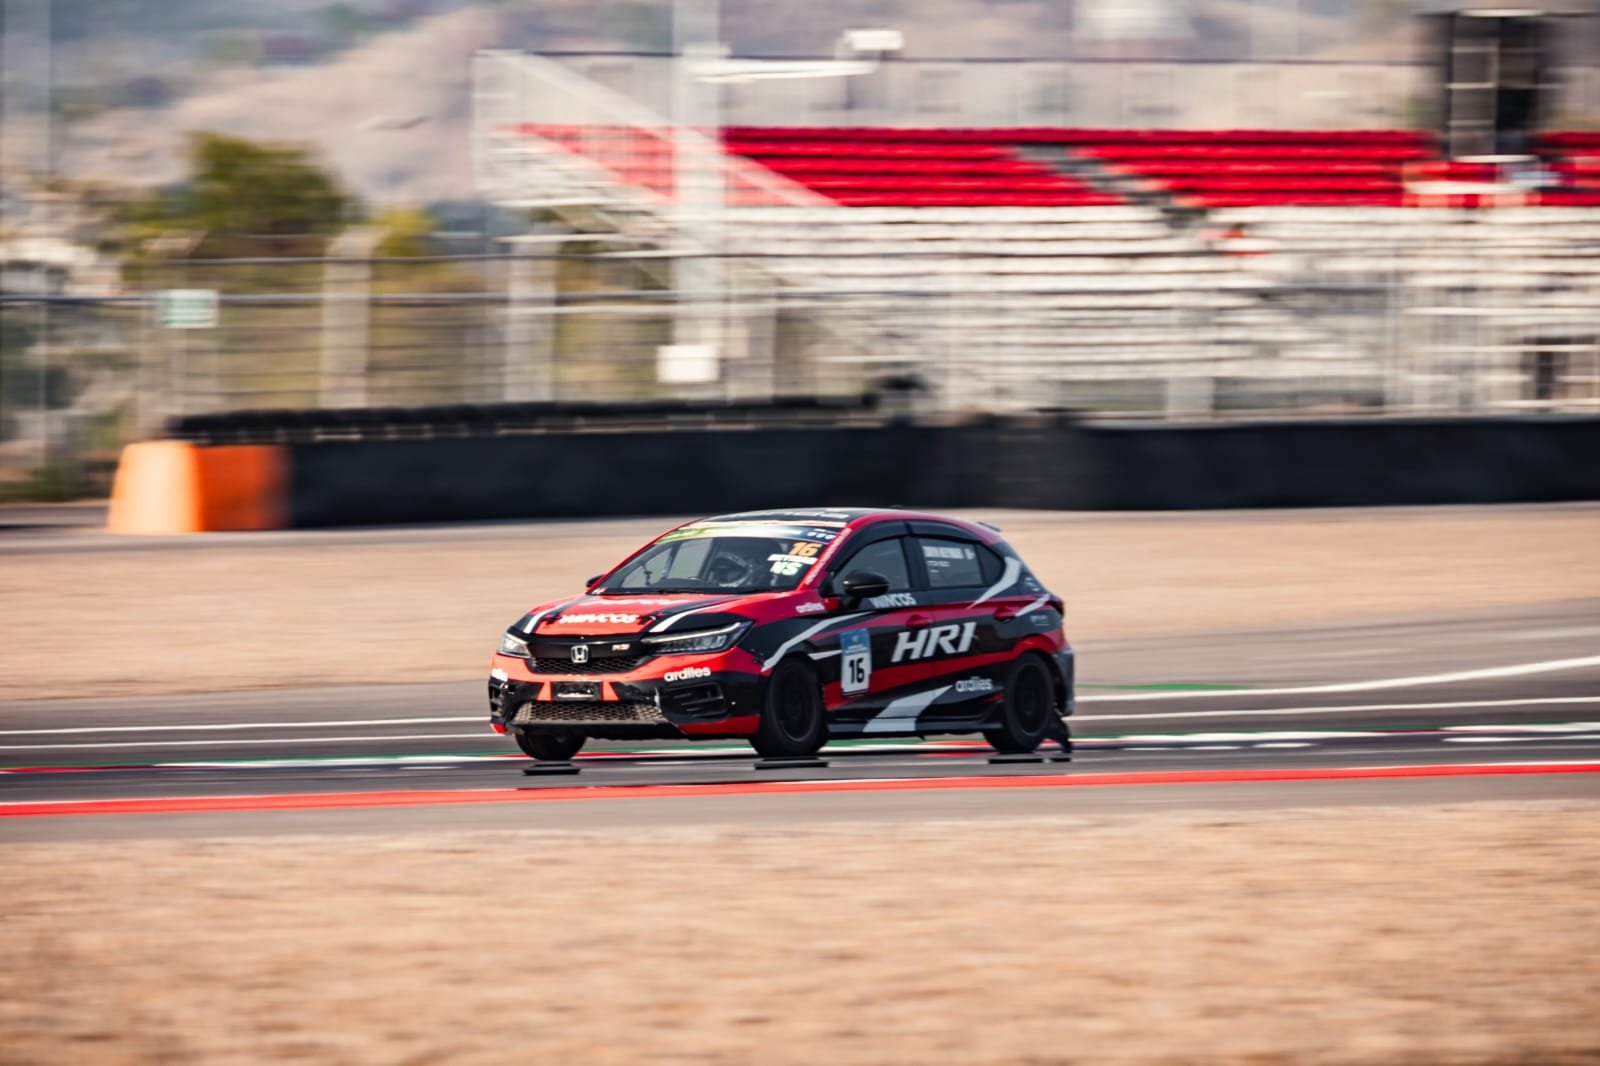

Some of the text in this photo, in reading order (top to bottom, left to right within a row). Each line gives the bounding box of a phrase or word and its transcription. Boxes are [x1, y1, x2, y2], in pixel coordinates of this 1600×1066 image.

[789, 542, 822, 558] 16
[891, 622, 977, 663] HRI
[663, 666, 711, 683] ardiles
[848, 657, 865, 684] 16
